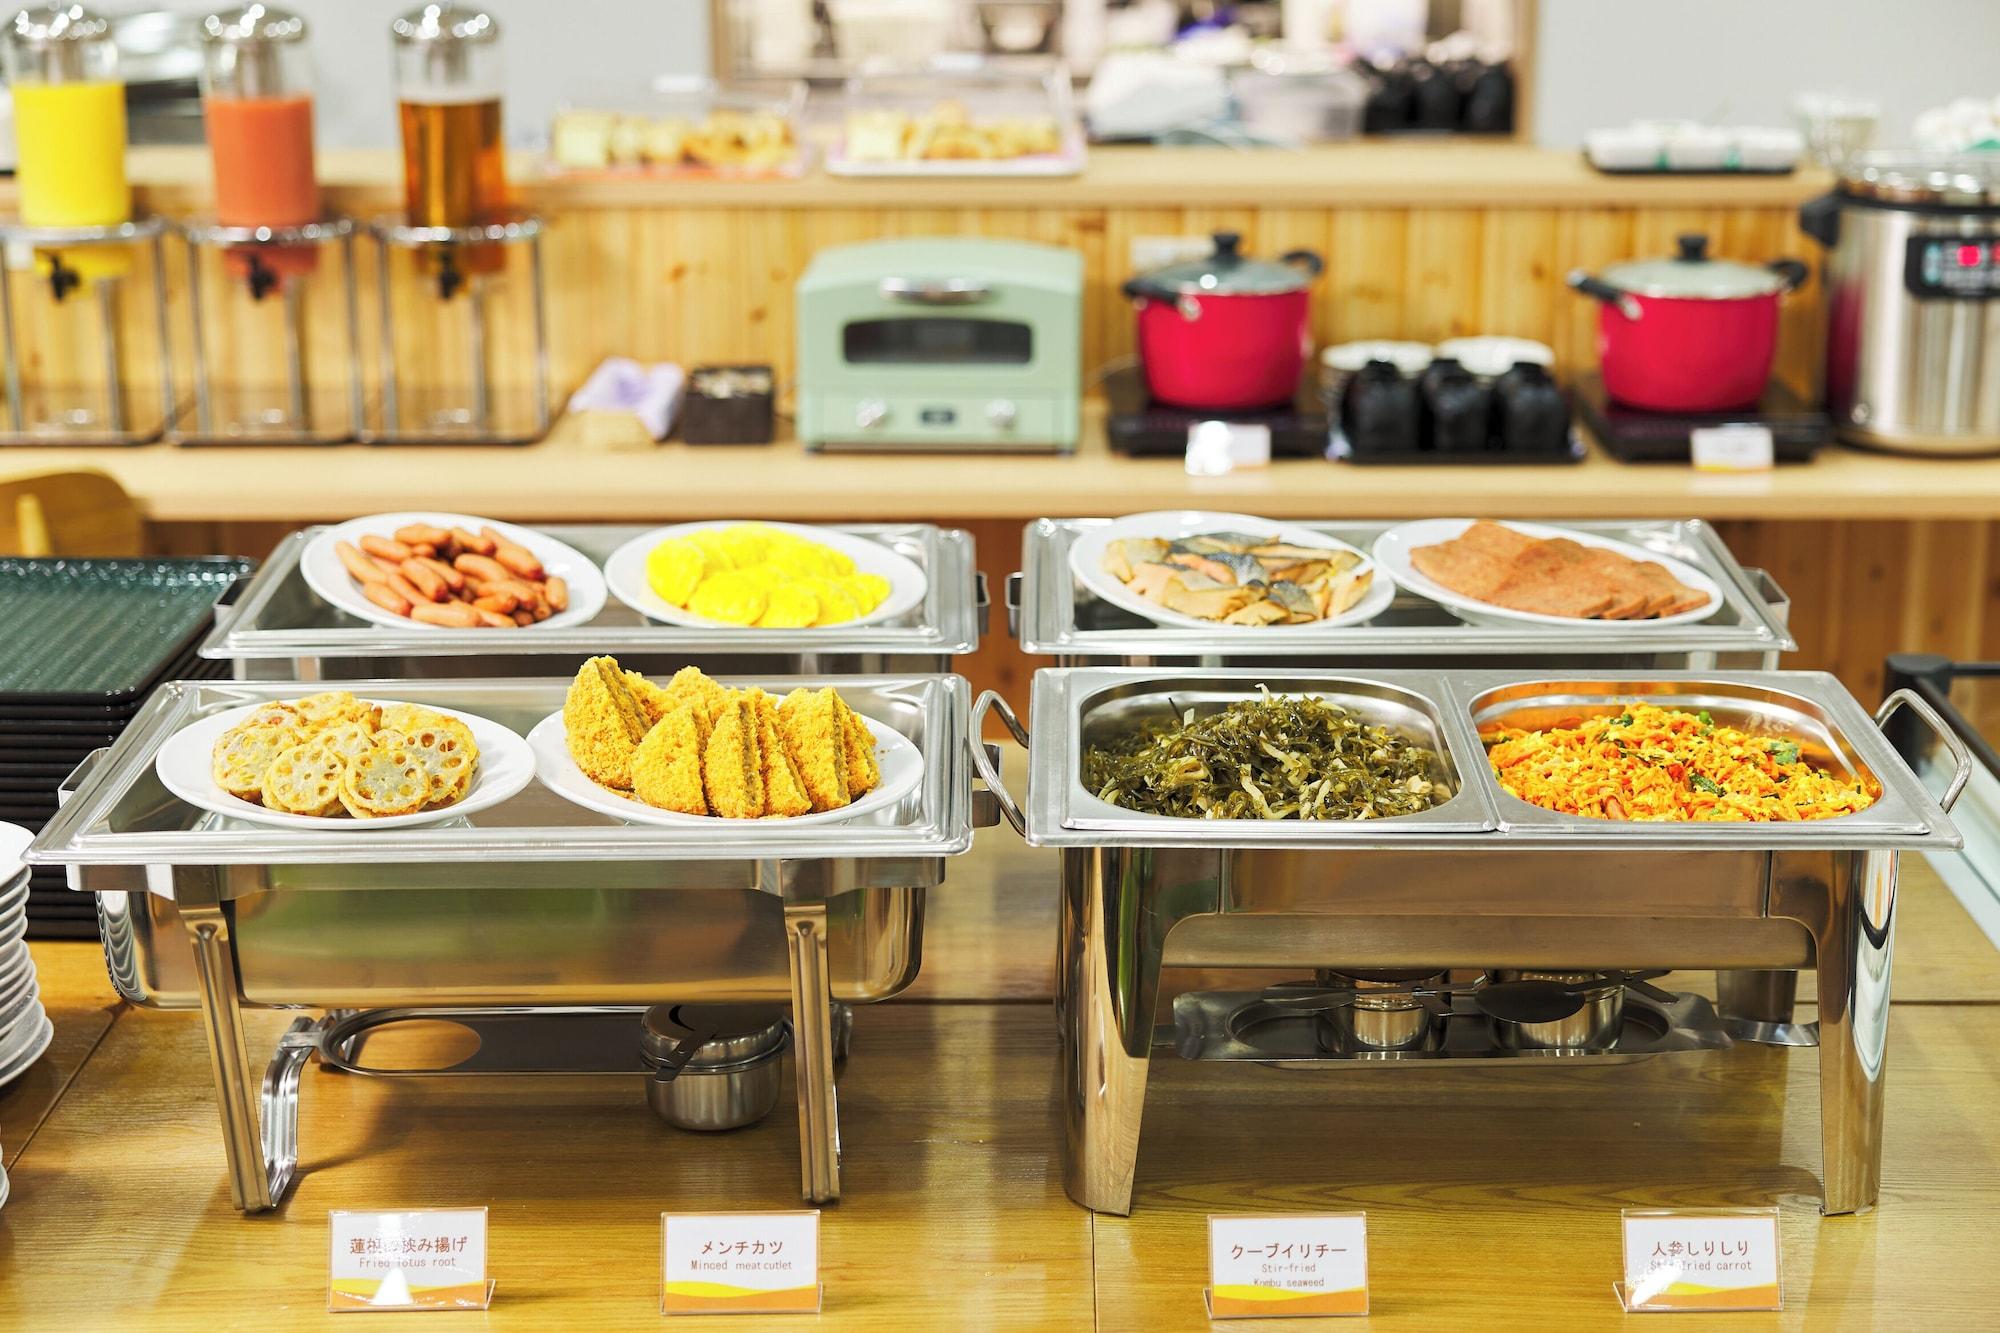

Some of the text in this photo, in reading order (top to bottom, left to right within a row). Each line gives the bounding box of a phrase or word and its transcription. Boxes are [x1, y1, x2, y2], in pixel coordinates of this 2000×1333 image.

[701, 1240, 783, 1255] メンチカツ
[1231, 1243, 1347, 1260] クーブイリチー
[1652, 1240, 1748, 1256] 人参しりしり
[359, 1257, 390, 1268] Fried
[432, 1257, 456, 1267] root
[690, 1259, 792, 1270] Minced meat cutlet
[1262, 1263, 1316, 1273] Stir-fried
[1650, 1259, 1752, 1271] Stfried carrot
[1254, 1277, 1324, 1288] Kombu seaweed
